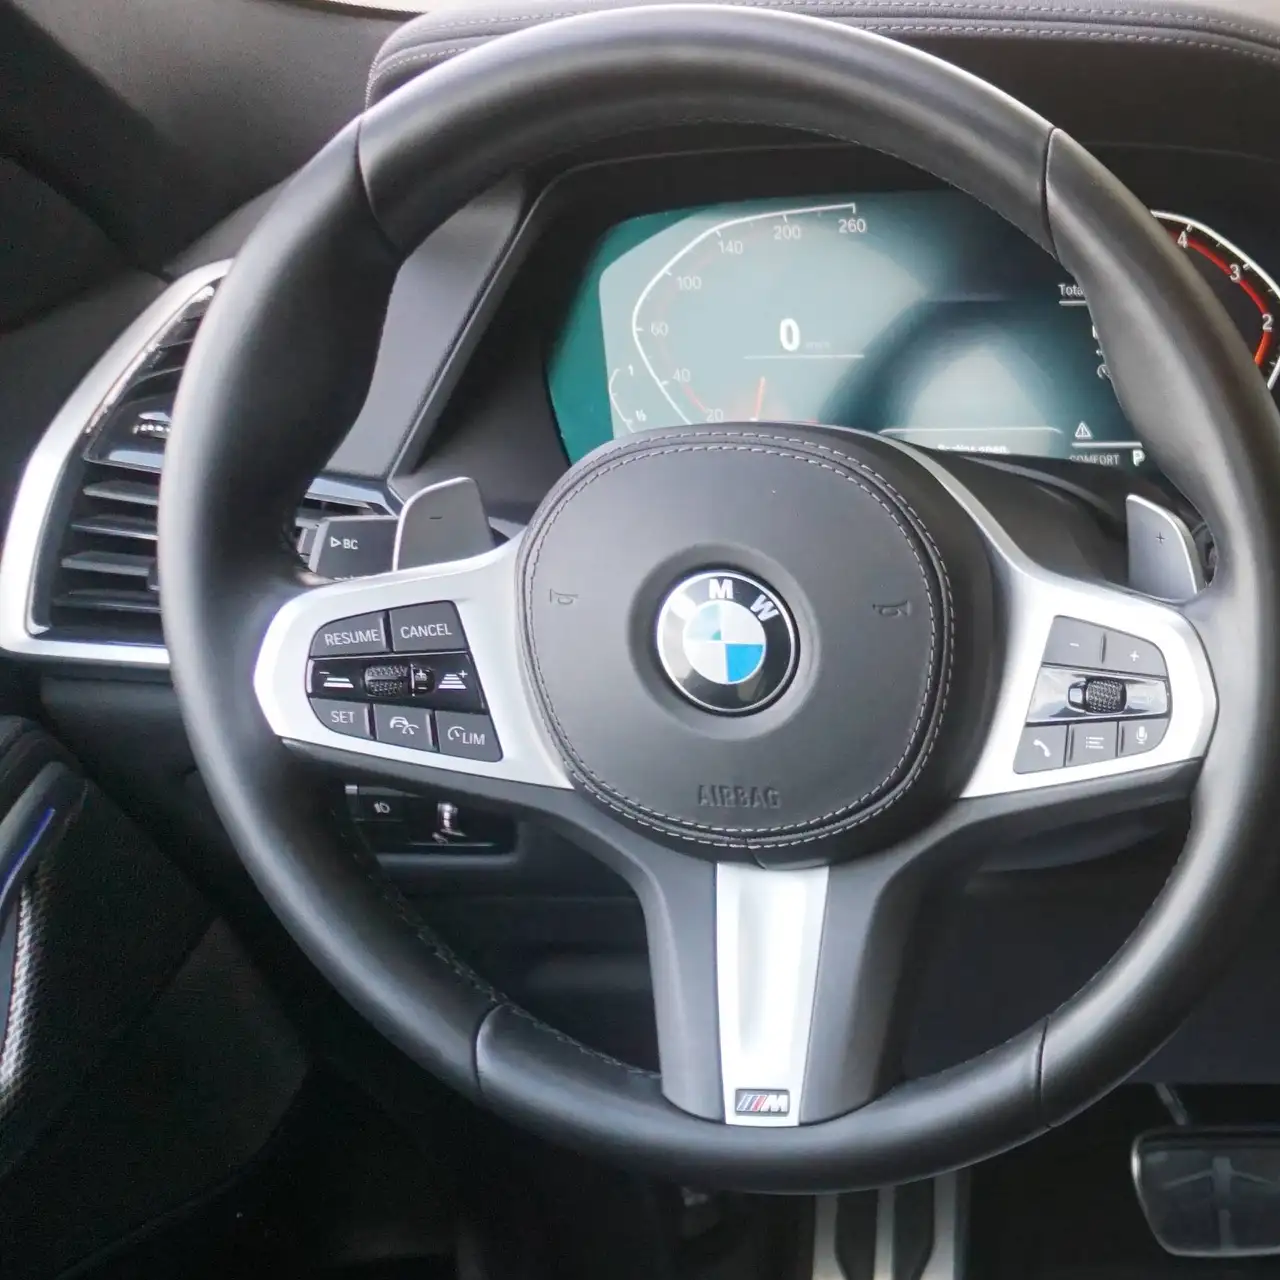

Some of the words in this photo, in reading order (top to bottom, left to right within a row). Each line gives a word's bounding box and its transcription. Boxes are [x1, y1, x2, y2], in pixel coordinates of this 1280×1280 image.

[774, 225, 801, 240] 200
[838, 218, 866, 234] 260
[718, 239, 743, 255] 140
[1177, 231, 1189, 248] 4
[1229, 264, 1241, 282] 3
[676, 276, 702, 291] 100
[1058, 283, 1084, 297] Tota
[651, 321, 669, 336] 60
[1262, 314, 1273, 332] 2
[779, 318, 800, 351] 0
[673, 369, 691, 384] 40
[706, 408, 724, 422] 20
[1132, 449, 1147, 467] P
[343, 538, 359, 550] BC
[324, 628, 381, 646] RESUME
[400, 623, 453, 639] CANCEL
[330, 711, 355, 724] SET
[462, 733, 486, 746] LIM
[697, 785, 782, 809] AIRBAG
